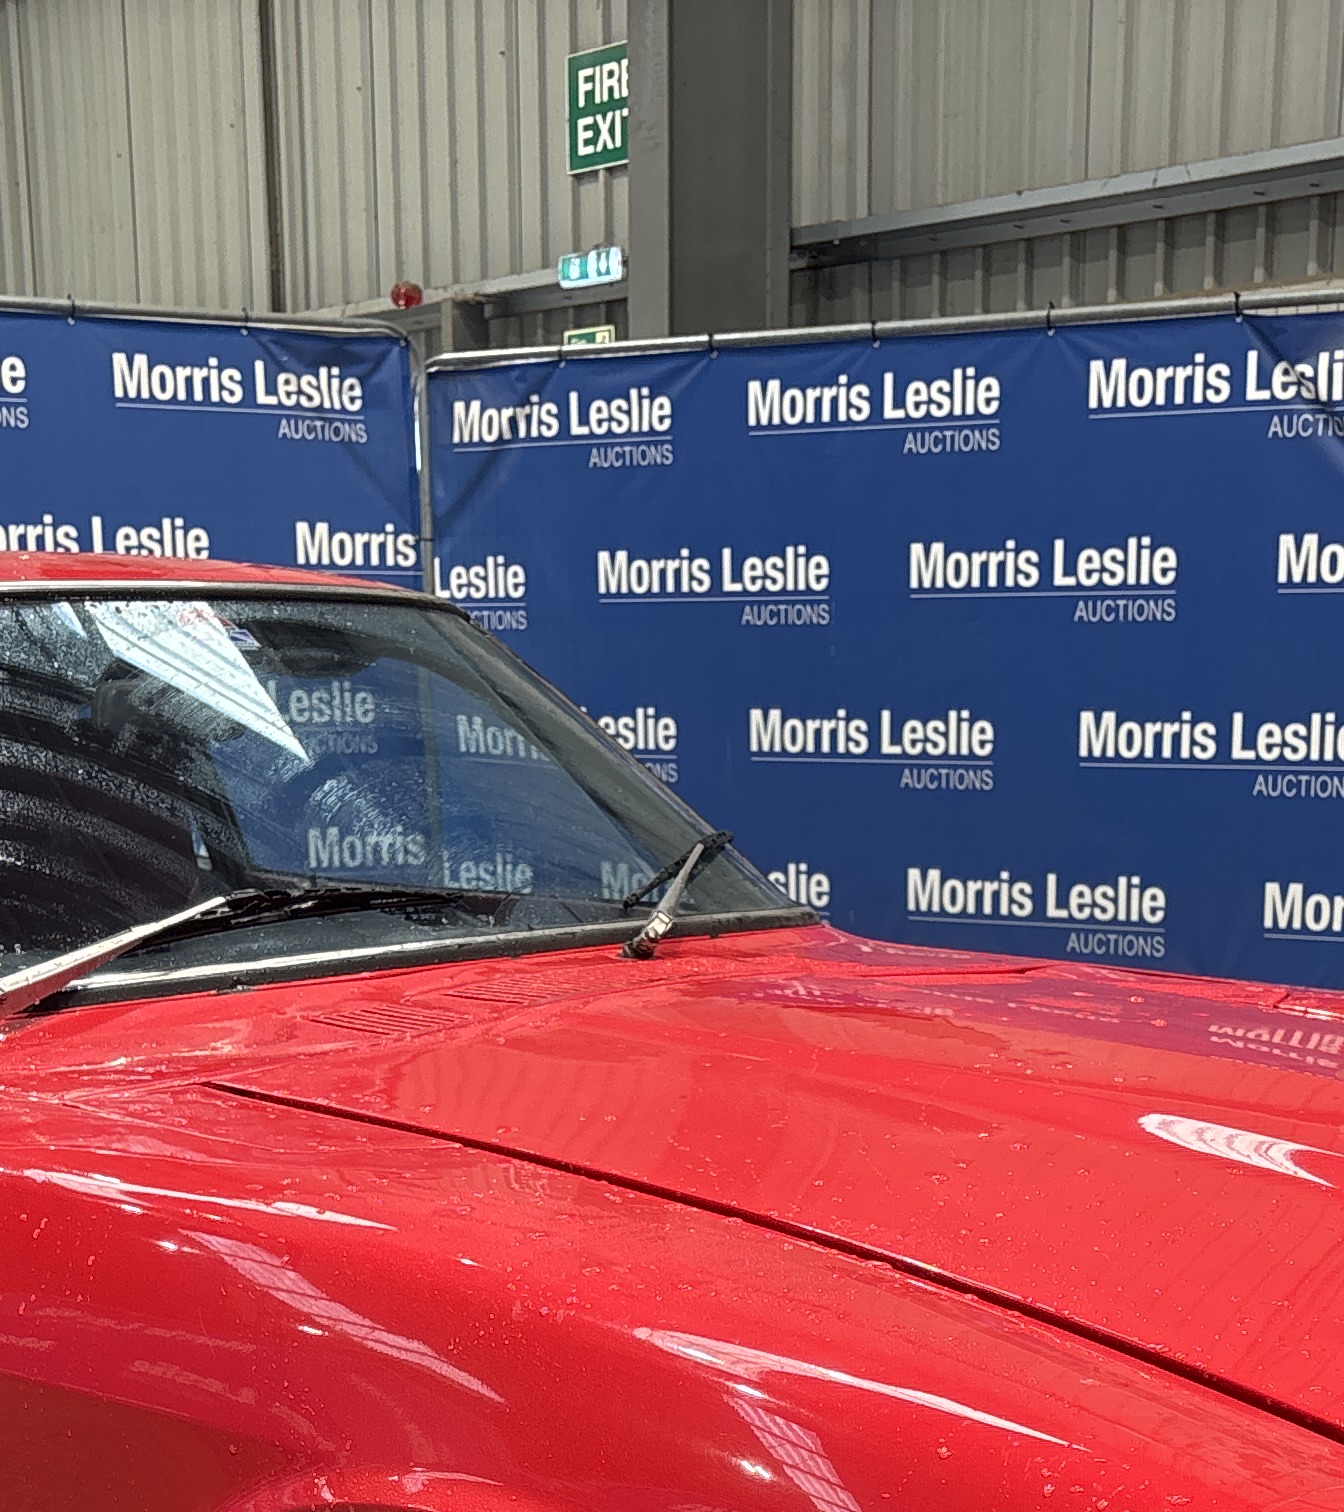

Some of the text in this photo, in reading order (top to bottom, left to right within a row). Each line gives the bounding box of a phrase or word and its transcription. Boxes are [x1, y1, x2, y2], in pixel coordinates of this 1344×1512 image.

[577, 107, 629, 156] EXI
[111, 352, 363, 412] Morris Leslie
[747, 366, 1001, 427] Morris Leslie
[1088, 352, 1231, 409] Morris
[277, 418, 368, 444] AUCTIONS
[452, 386, 672, 444] Morris Leslie
[588, 443, 674, 468] AUCTIONS
[902, 427, 1001, 454] AUCTIONS
[91, 515, 210, 560] Leslie
[295, 521, 526, 599] Morris Leslie
[909, 535, 1178, 589] Morris Leslie
[597, 544, 830, 595] Morris Leslie
[739, 601, 832, 628] AUCTIONS
[1073, 598, 1176, 623] AUCTIONS
[580, 706, 677, 751] eslie
[749, 708, 994, 757] Morris Leslie
[1079, 710, 1217, 760] Morris
[899, 767, 994, 791] AUCTIONS
[767, 862, 831, 908] slie
[907, 867, 1166, 924] Morris Leslie
[1066, 932, 1166, 958] AUCTIONS
